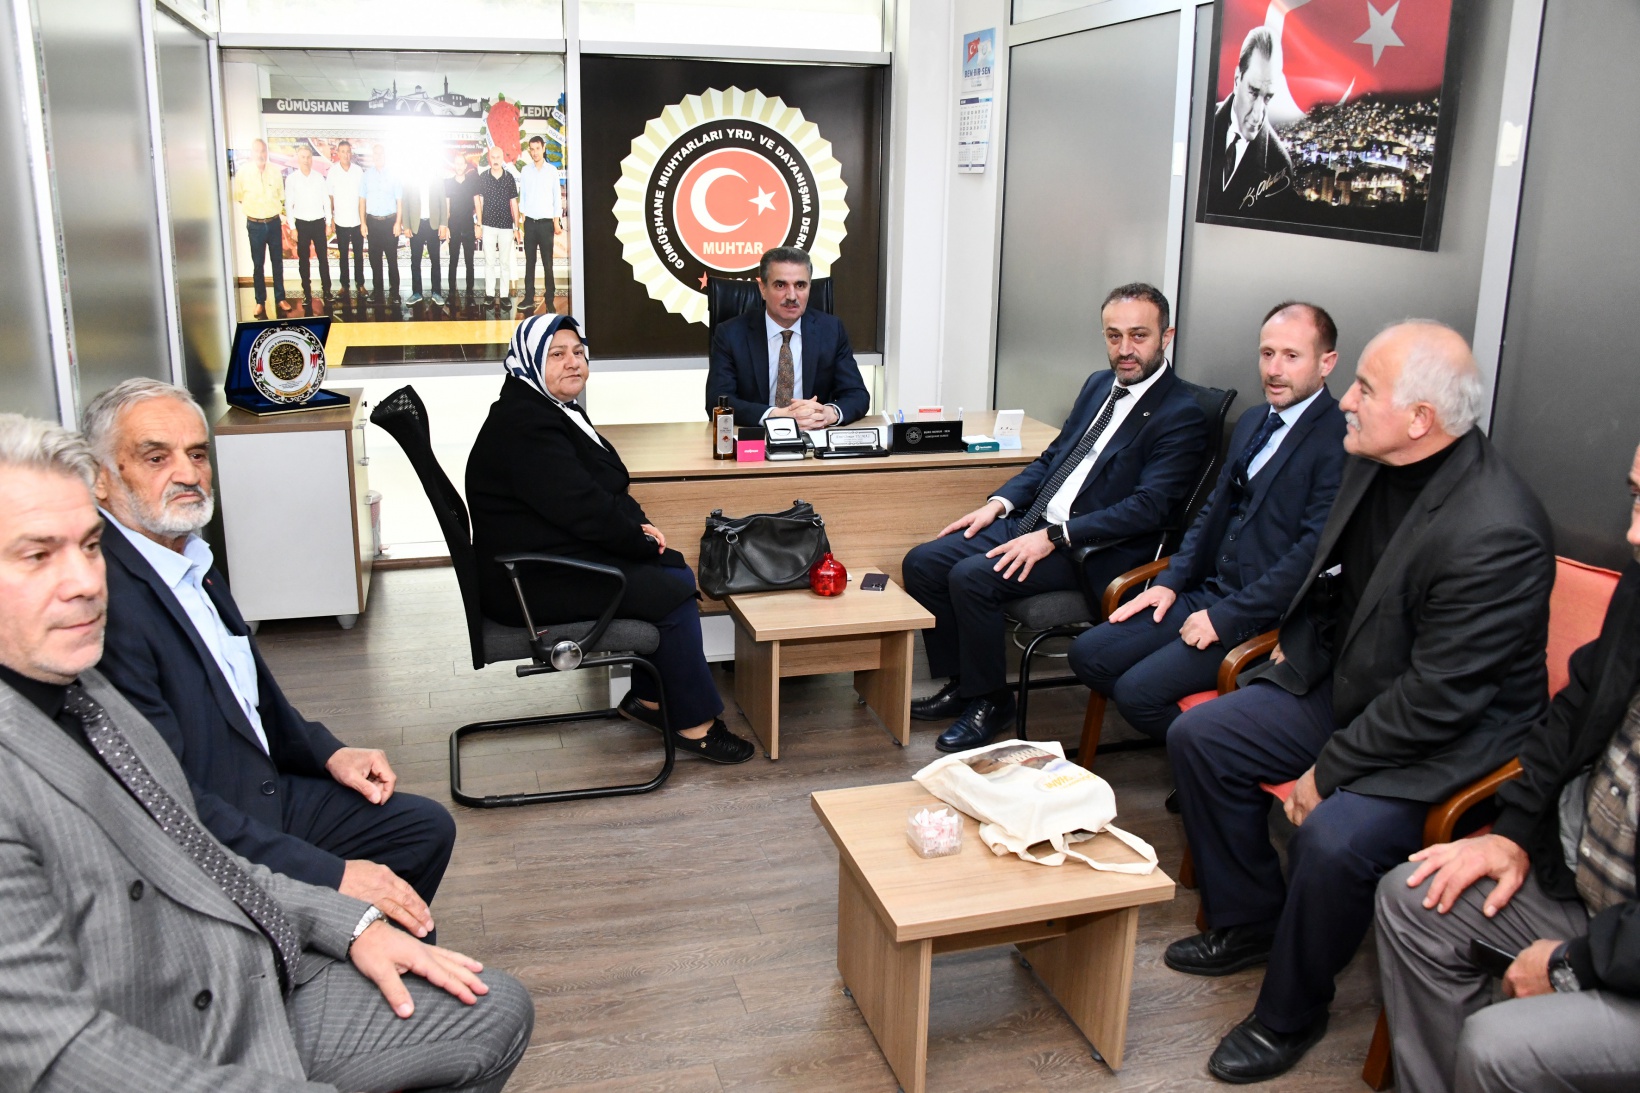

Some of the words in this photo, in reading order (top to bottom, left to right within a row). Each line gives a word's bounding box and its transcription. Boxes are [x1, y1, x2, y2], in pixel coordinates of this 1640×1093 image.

[276, 98, 349, 112] GÜMÜŞHANE
[520, 105, 553, 117] LEDİY
[726, 128, 755, 142] YRD.
[759, 134, 775, 150] VE
[658, 129, 723, 188] MUHTARLARI
[774, 145, 811, 214] DAYANIŞMA
[653, 189, 685, 270] GÜMÜŞHANE
[793, 217, 811, 250] DERN
[702, 241, 764, 255] MUHTAR
